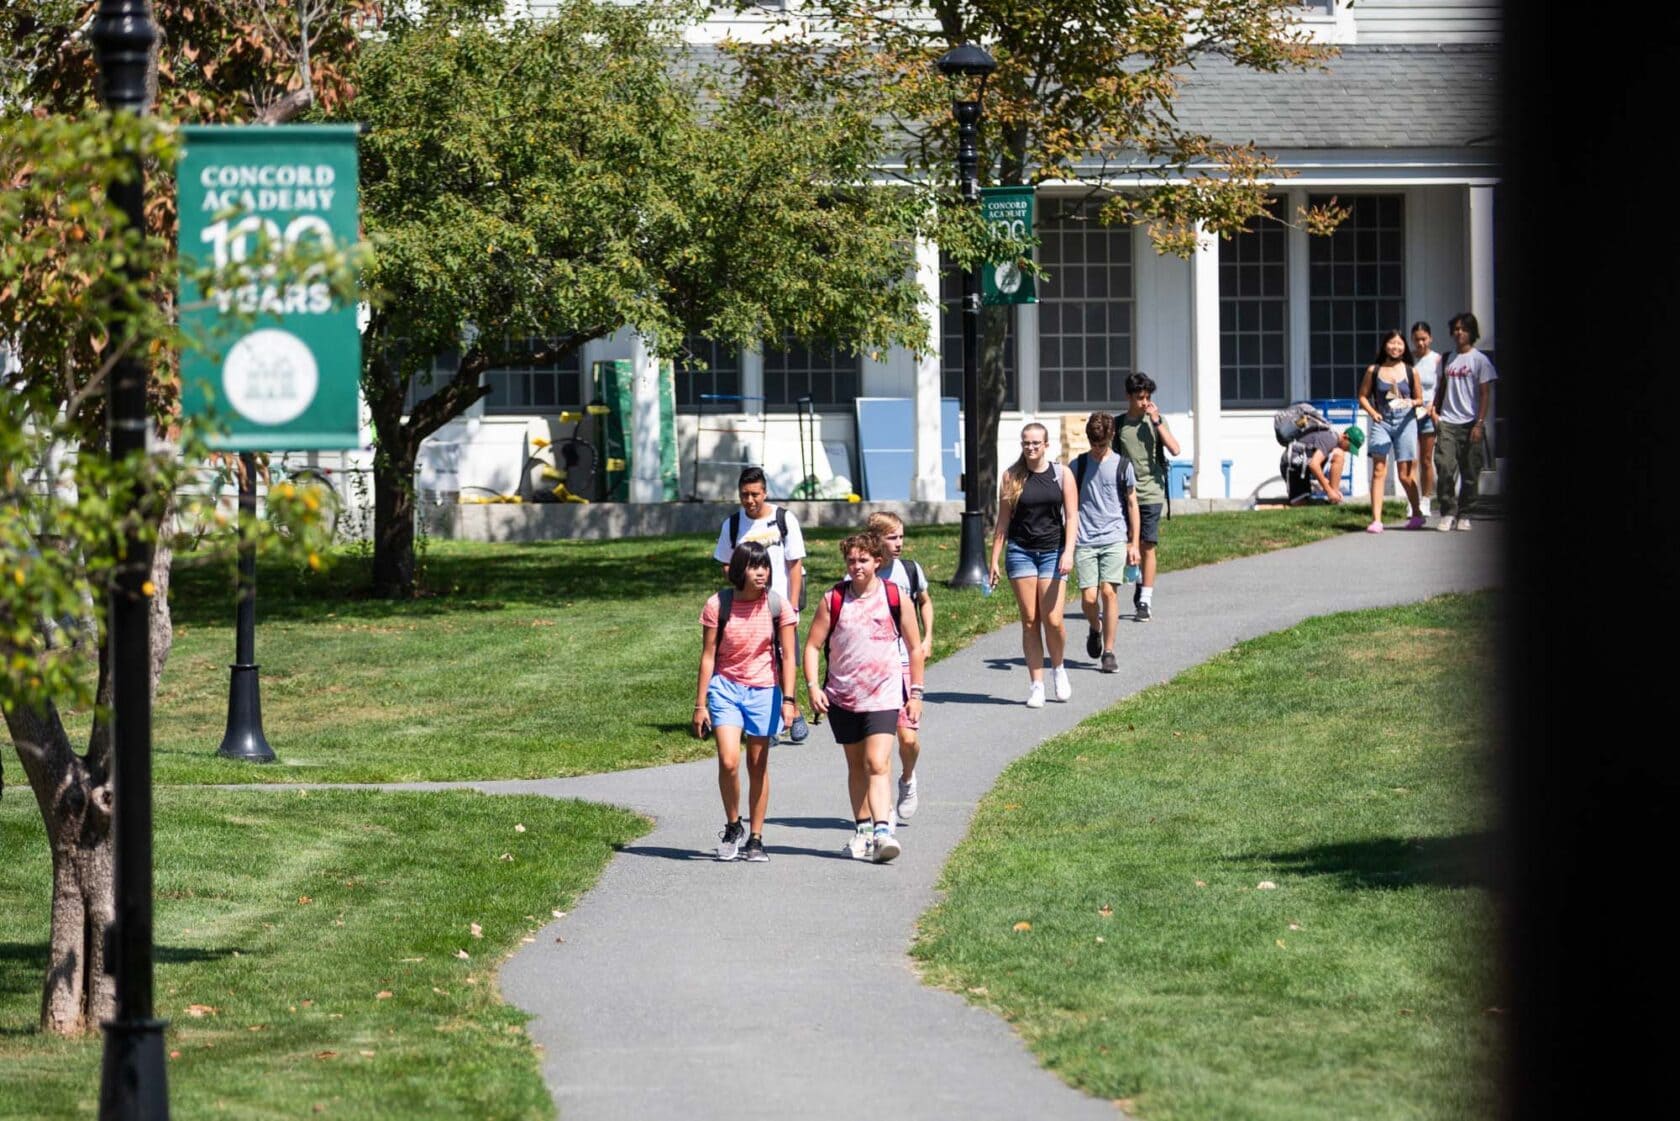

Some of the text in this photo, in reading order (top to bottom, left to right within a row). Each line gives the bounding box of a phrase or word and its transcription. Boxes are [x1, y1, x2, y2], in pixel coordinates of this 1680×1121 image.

[201, 165, 335, 188] CONCORD
[202, 189, 335, 211] ACADEMY
[988, 201, 1027, 210] CONCORD
[201, 215, 334, 281] 100
[215, 283, 332, 314] YEARS
